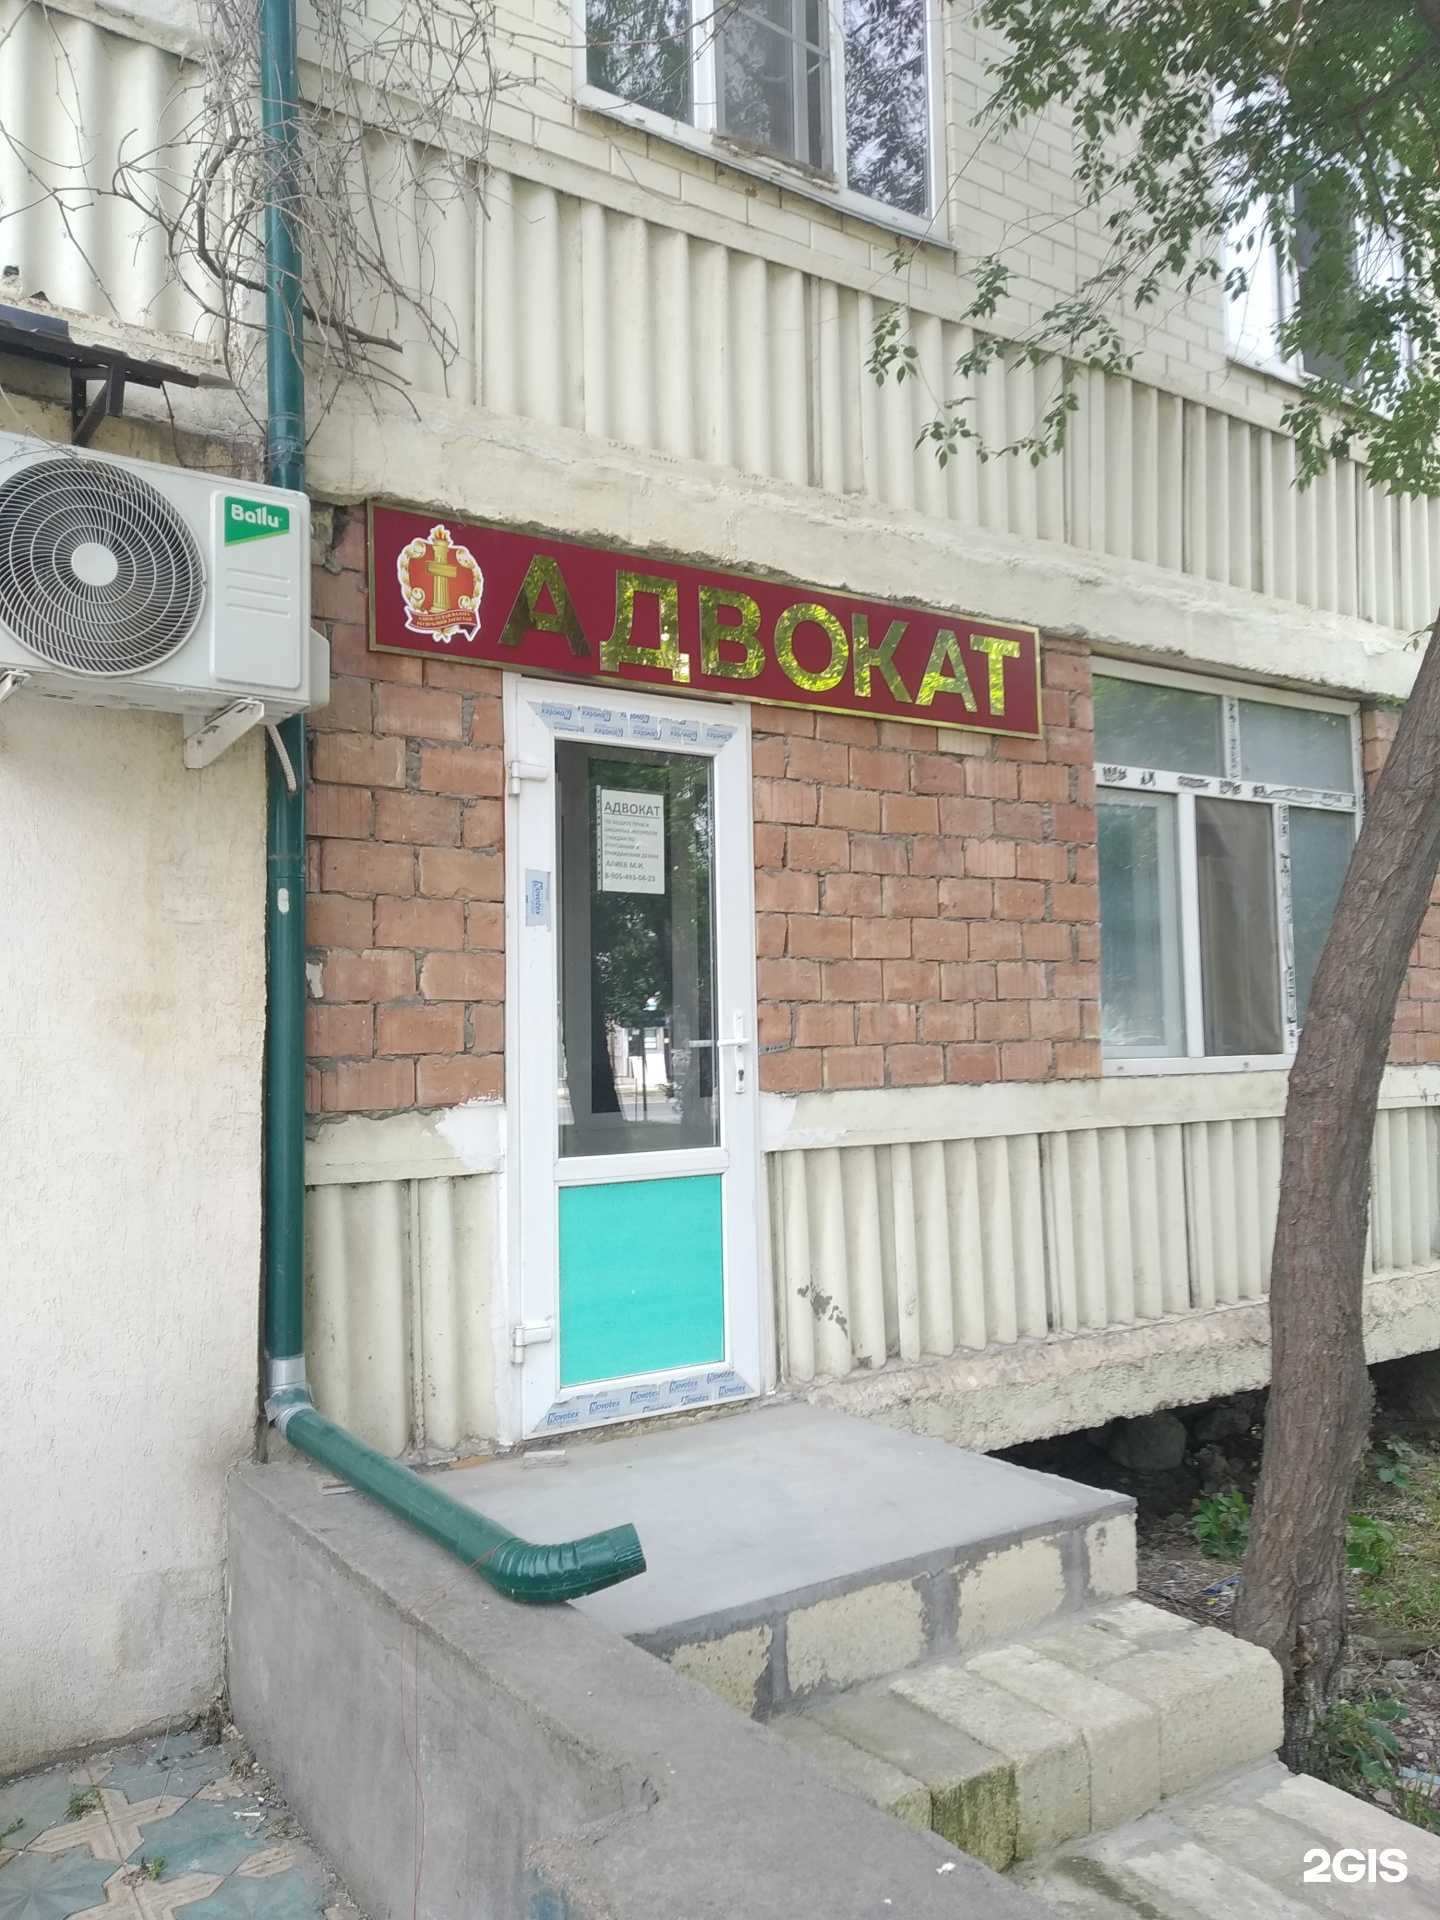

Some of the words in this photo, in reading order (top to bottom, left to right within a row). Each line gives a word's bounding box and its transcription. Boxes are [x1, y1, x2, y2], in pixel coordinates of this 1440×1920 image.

[231, 503, 279, 528] Ballu
[499, 553, 1021, 716] АДВОКАТ
[604, 801, 660, 816] АДВОКАТ
